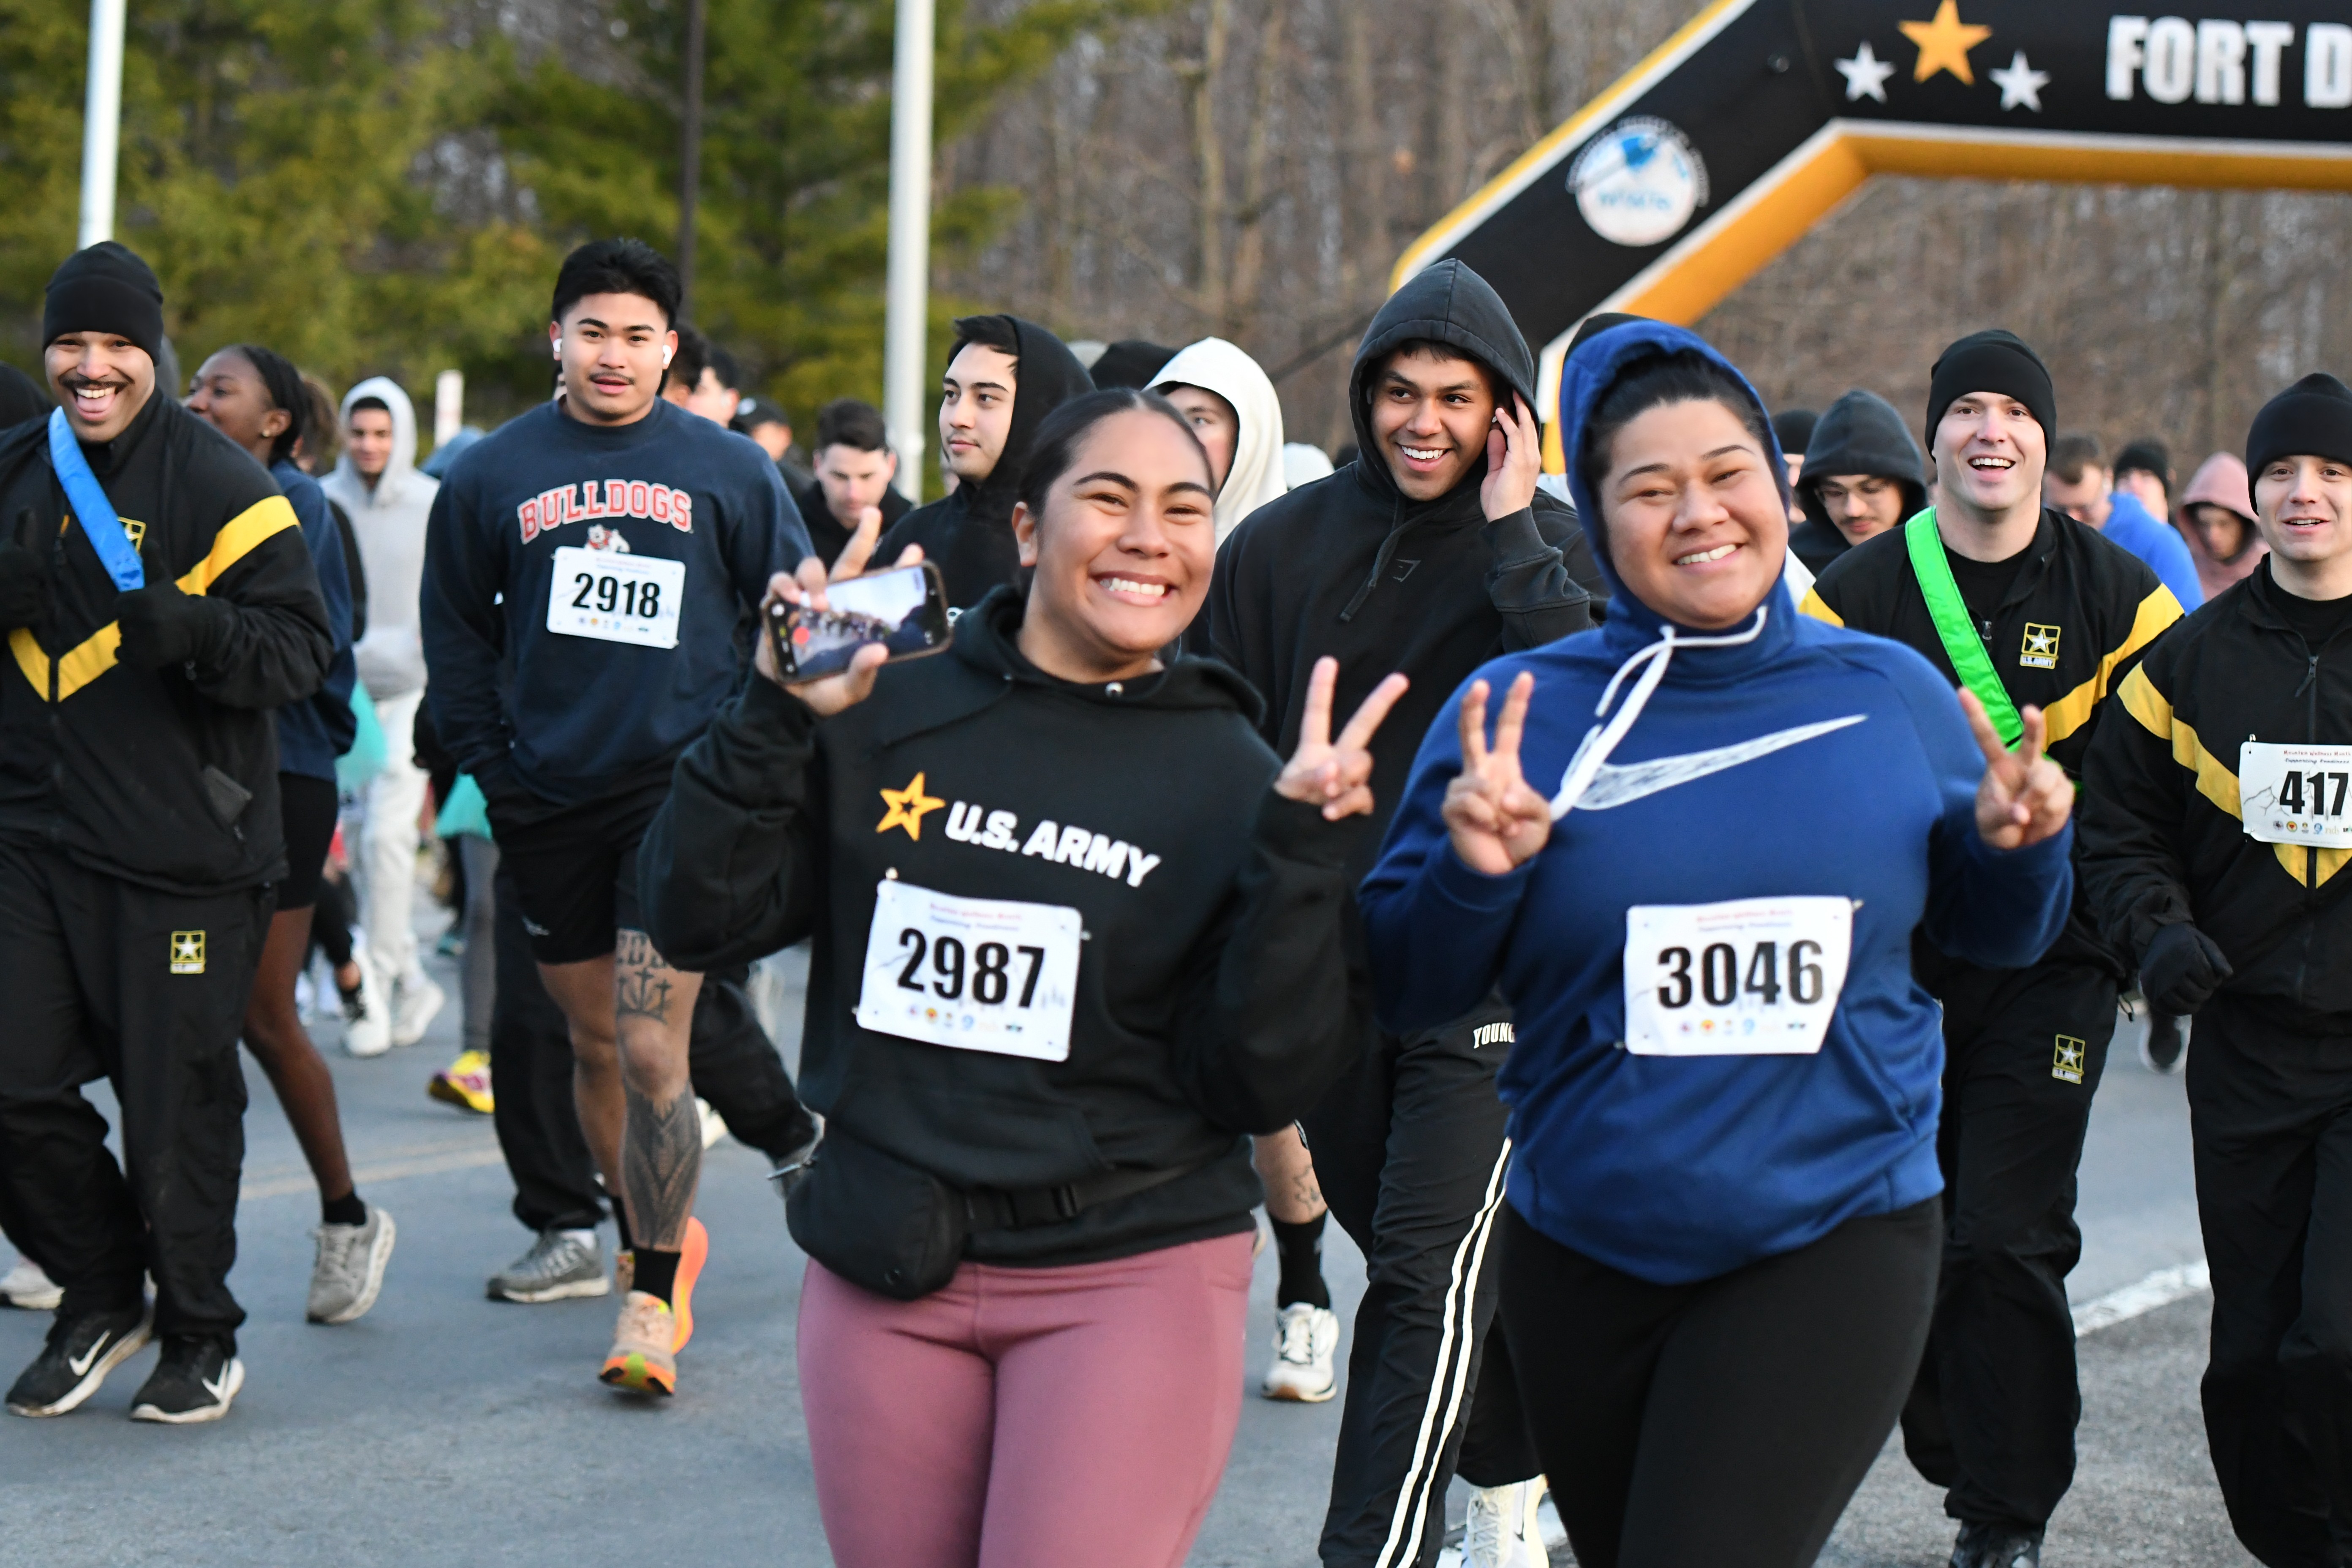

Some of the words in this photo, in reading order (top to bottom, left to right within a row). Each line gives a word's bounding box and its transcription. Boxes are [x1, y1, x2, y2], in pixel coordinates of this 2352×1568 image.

[2105, 14, 2295, 106] FORT
[2304, 22, 2352, 109] D
[517, 479, 692, 544] BULLDOGS
[572, 573, 660, 618] 2918
[2279, 771, 2349, 816] 417
[945, 800, 1019, 852] U.S.
[1021, 819, 1161, 887] ARMY
[897, 928, 1045, 1008] 2987
[1657, 939, 1823, 1009] 3046
